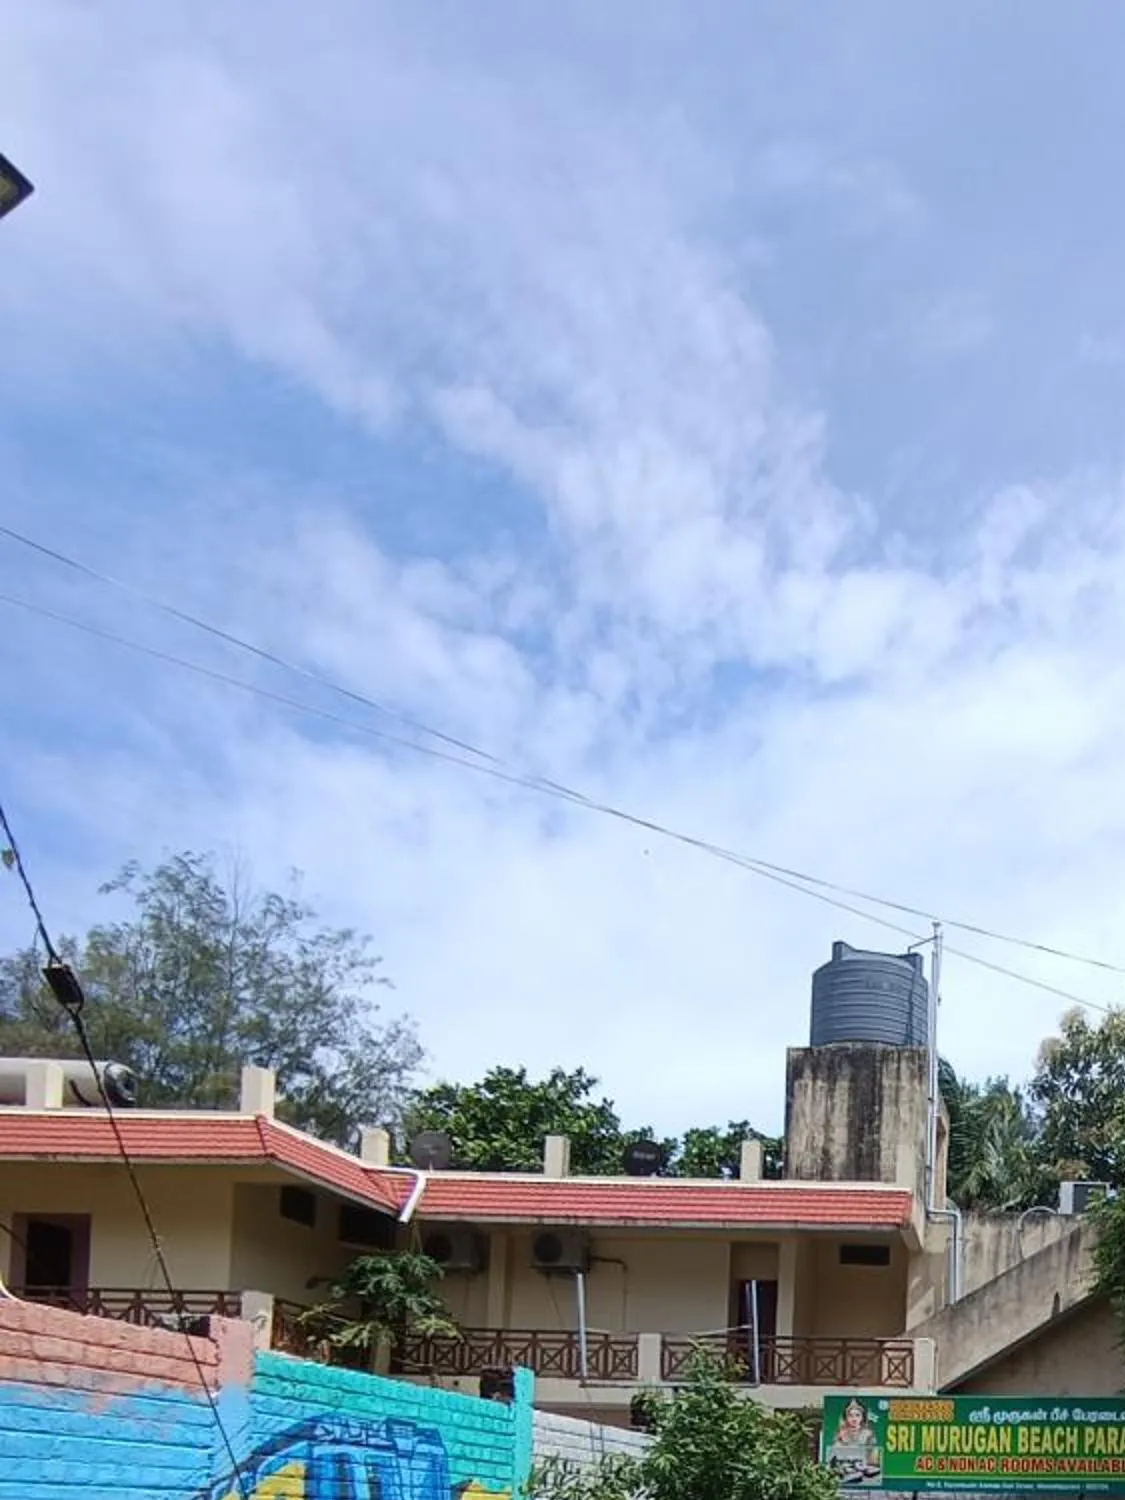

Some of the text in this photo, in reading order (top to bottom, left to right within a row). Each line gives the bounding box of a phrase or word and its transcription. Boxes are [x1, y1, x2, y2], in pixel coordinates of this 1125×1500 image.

[886, 1425, 915, 1452] SRI
[921, 1425, 1012, 1453] MURUGAN
[1018, 1425, 1079, 1454] BEACH
[916, 1456, 933, 1472] AC
[1001, 1456, 1055, 1473] ROOMS
